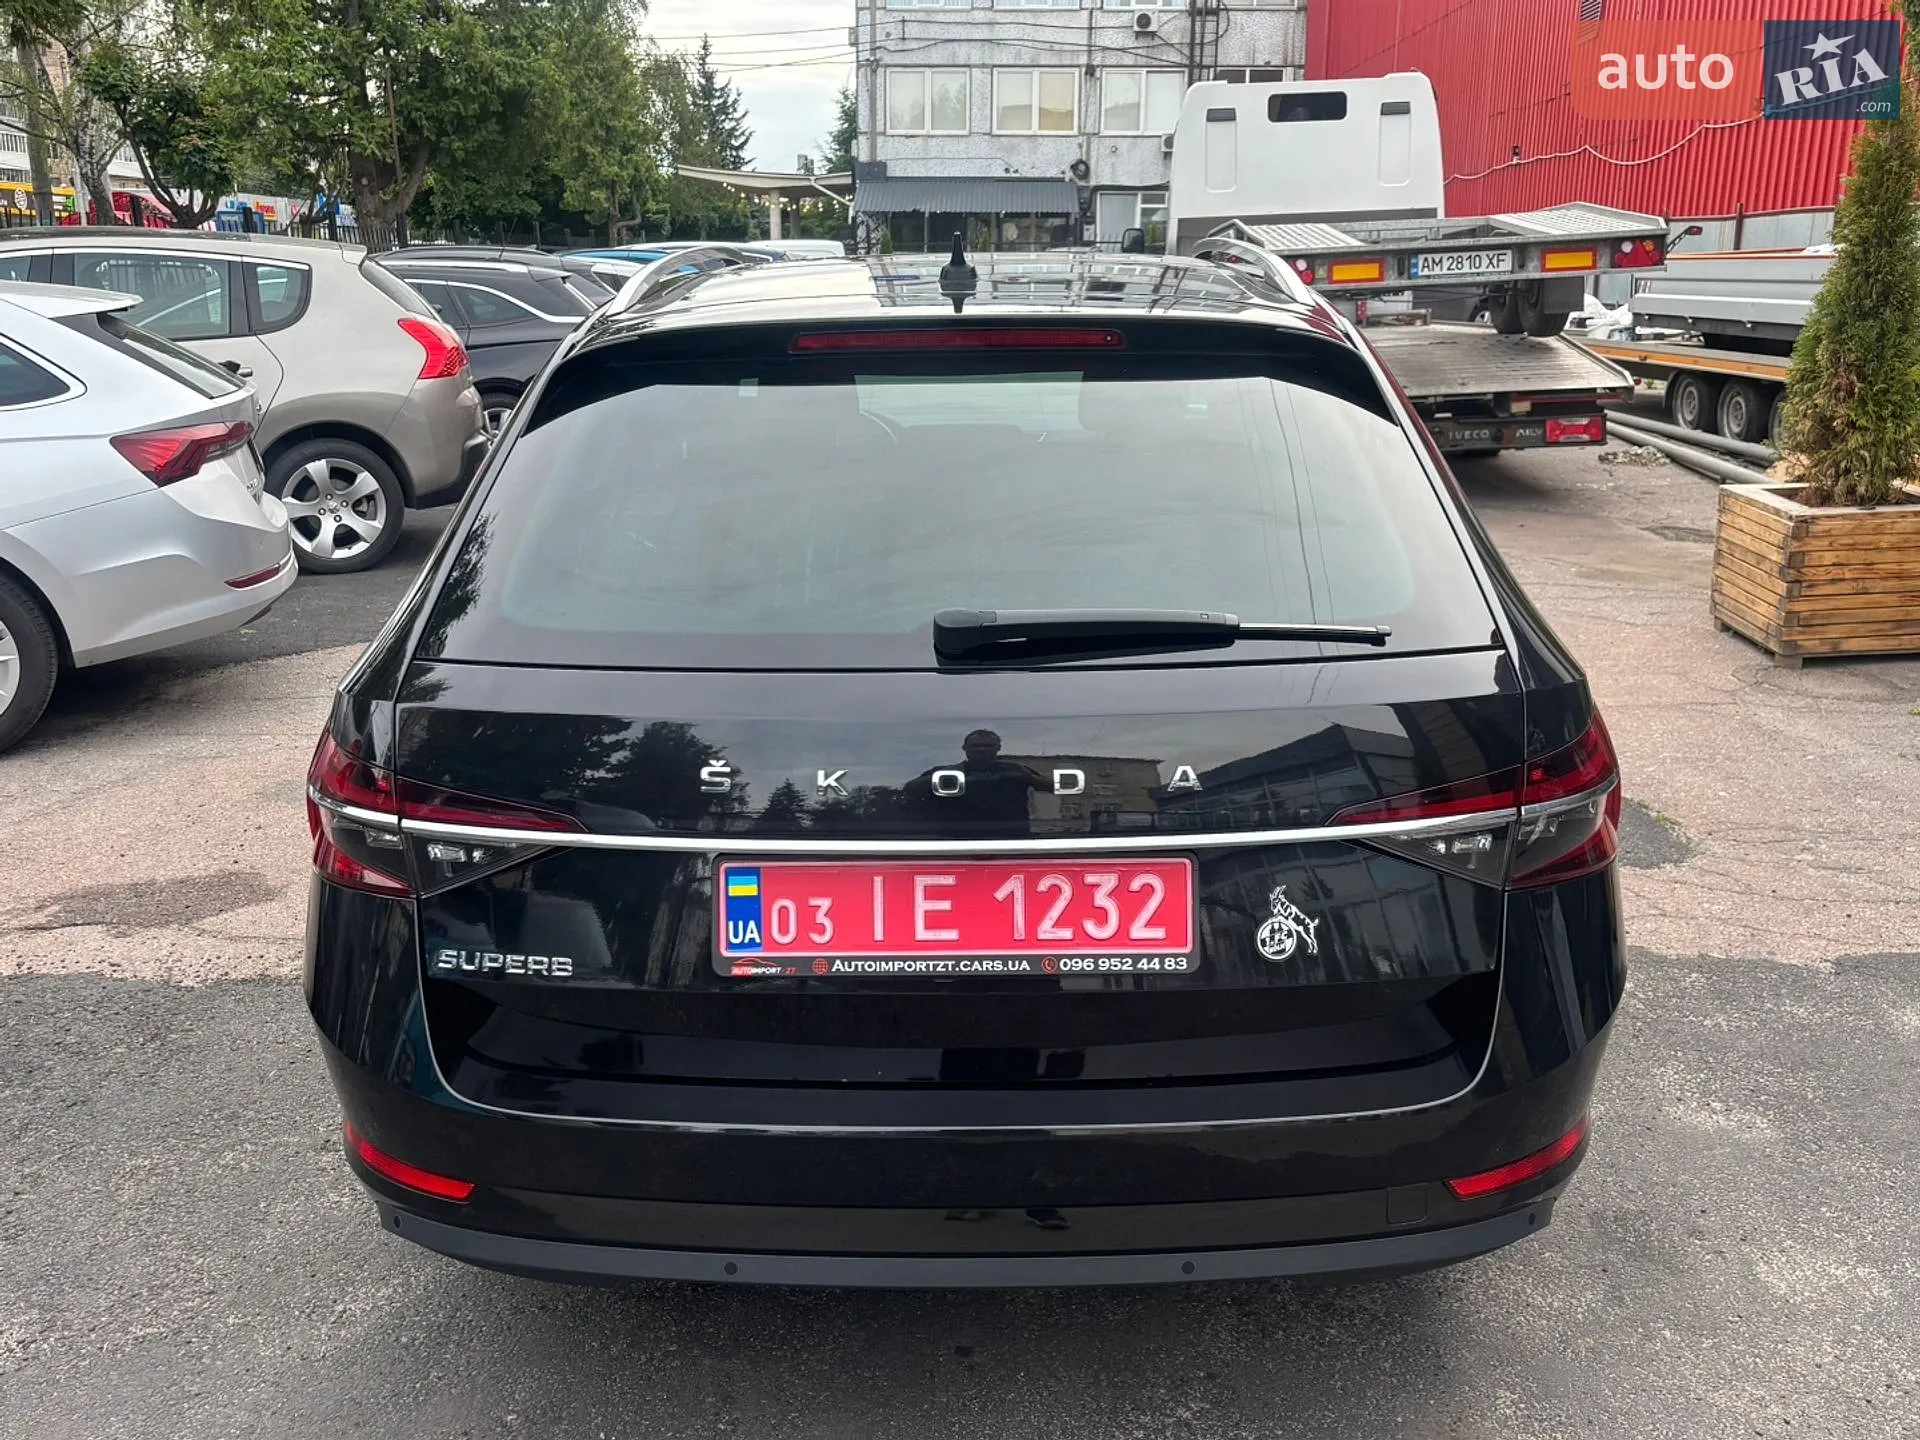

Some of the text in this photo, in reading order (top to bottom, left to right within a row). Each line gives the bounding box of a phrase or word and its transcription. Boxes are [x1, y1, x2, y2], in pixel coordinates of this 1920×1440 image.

[1421, 252, 1508, 273] AM 2810 XF
[1449, 429, 1490, 440] IVECO
[699, 759, 1204, 796] ŠKODA
[769, 897, 835, 944] 03
[992, 873, 1168, 941] 1232
[728, 920, 761, 944] UA
[437, 949, 574, 977] SUPERB
[1059, 957, 1188, 971] 096 952 44 83
